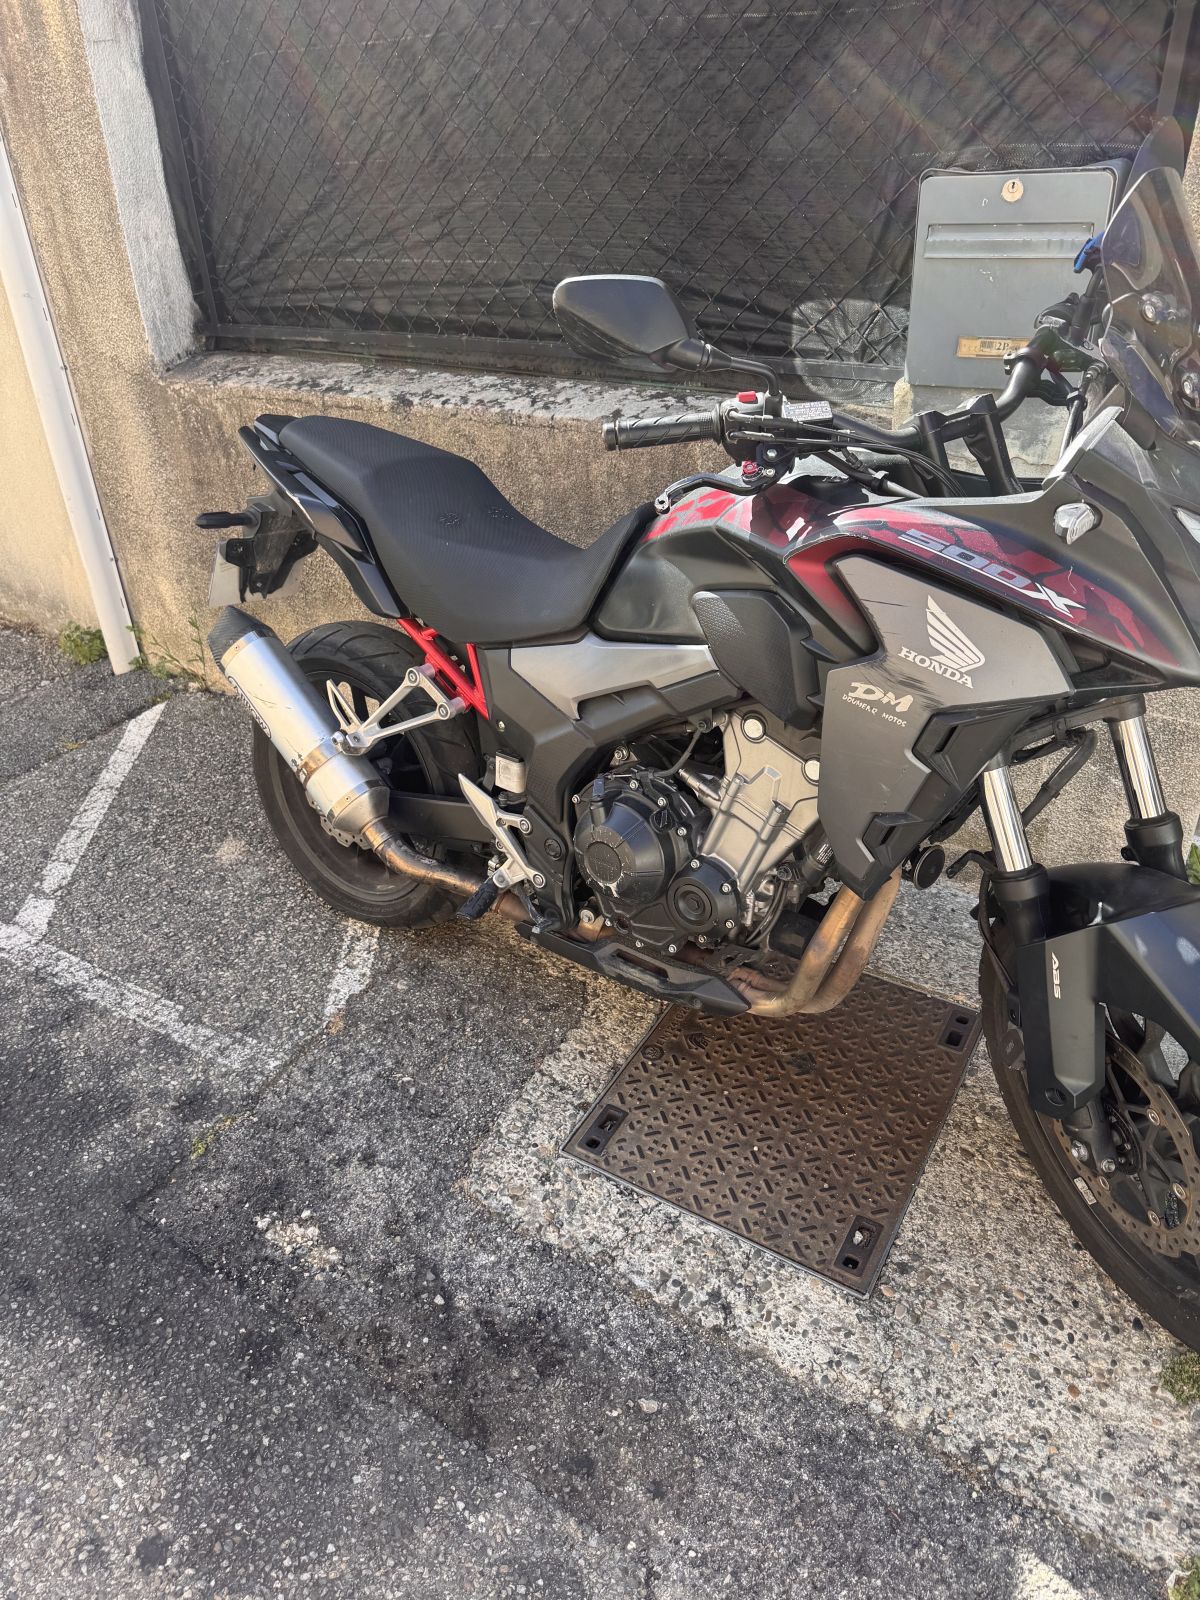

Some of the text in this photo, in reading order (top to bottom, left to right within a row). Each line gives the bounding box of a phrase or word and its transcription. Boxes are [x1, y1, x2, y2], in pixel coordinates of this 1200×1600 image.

[898, 646, 974, 689] HONDA
[848, 682, 914, 712] DM
[1051, 951, 1061, 1000] ABS
